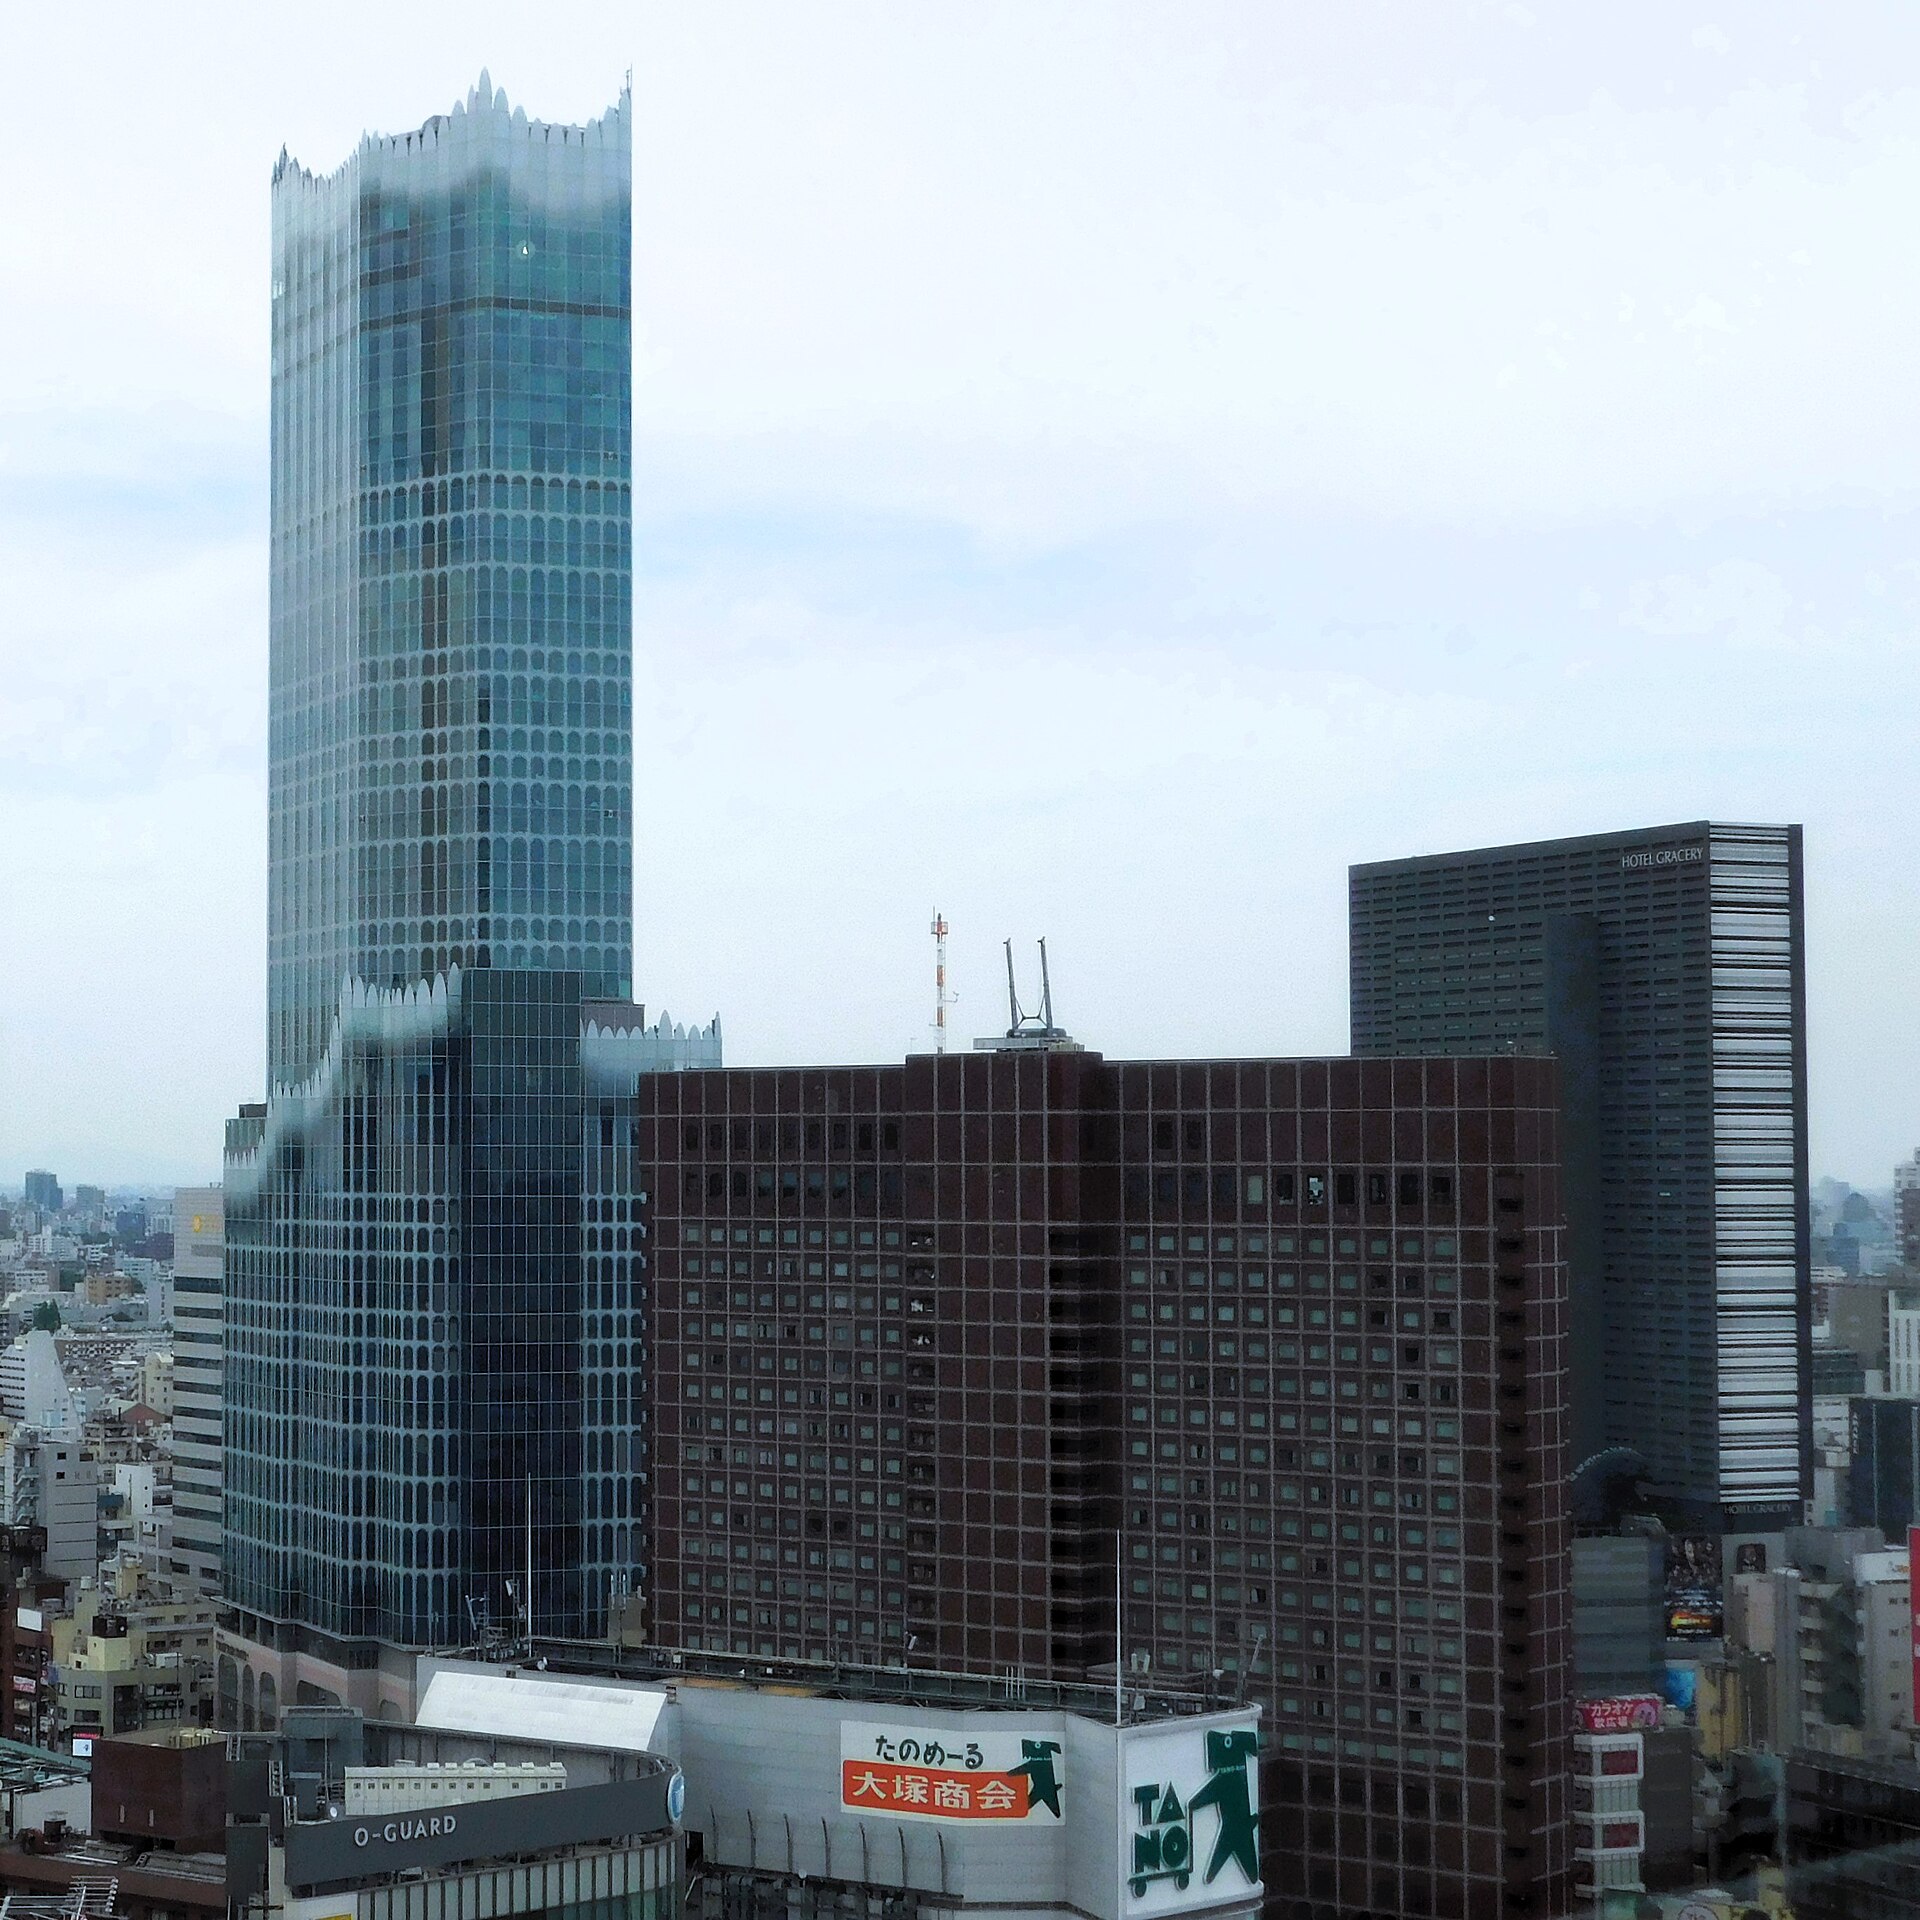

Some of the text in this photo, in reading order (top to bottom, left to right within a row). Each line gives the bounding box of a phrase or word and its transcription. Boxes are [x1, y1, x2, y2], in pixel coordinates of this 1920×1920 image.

[1622, 847, 1704, 868] HOTEL GRACERY
[1591, 1701, 1634, 1717] カラオケ
[875, 1735, 984, 1769] たのめーる
[851, 1771, 1017, 1810] 大塚商会
[354, 1815, 457, 1847] O-GUARD
